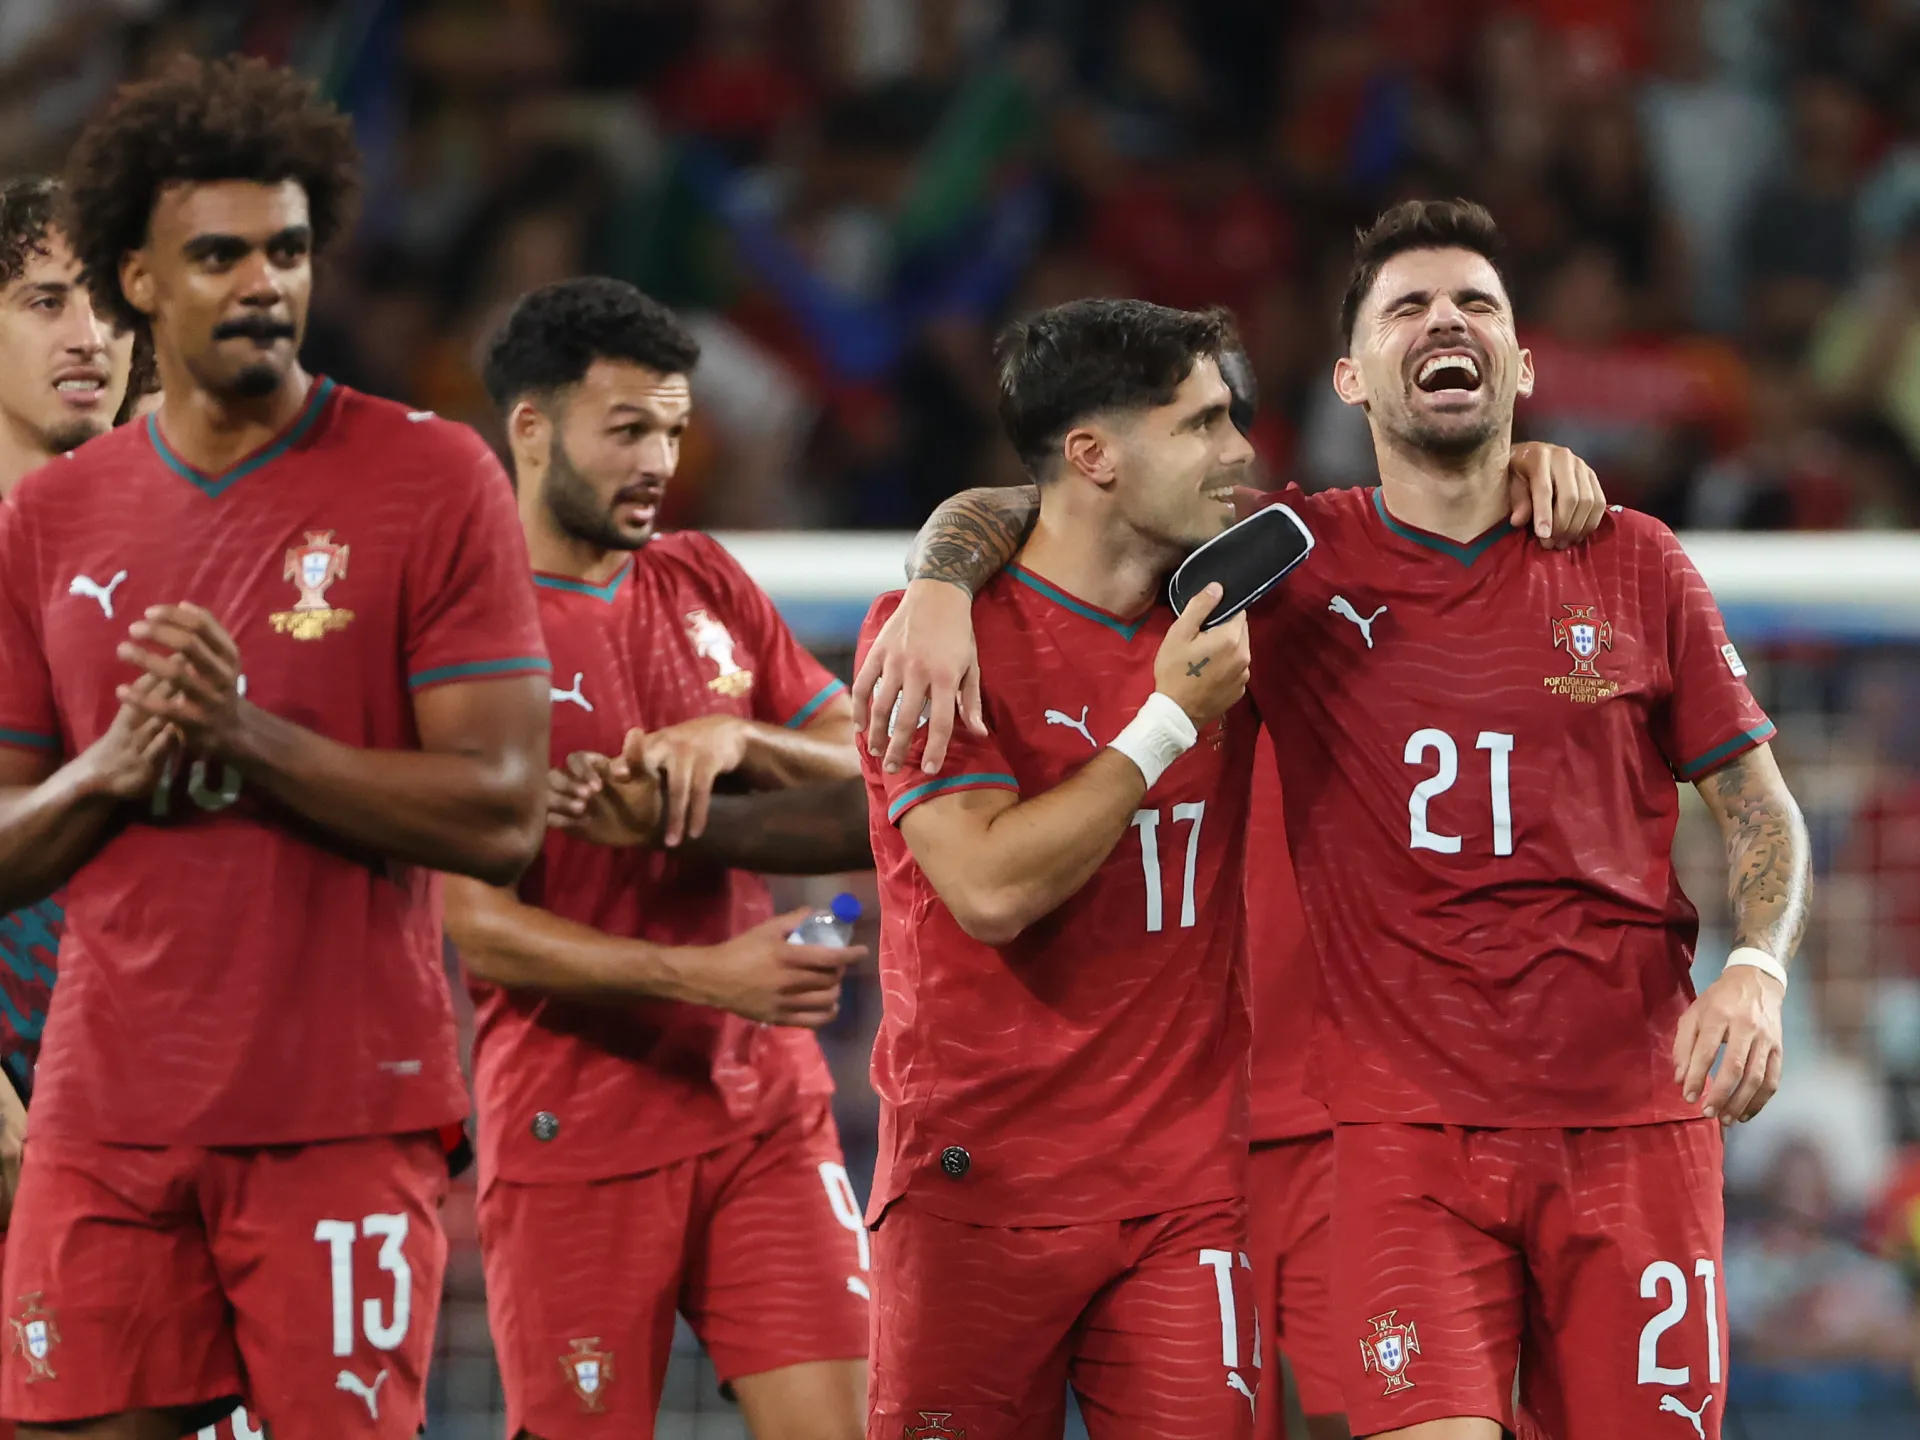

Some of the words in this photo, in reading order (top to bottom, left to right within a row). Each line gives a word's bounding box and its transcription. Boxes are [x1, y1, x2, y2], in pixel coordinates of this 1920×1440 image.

[1551, 686, 1557, 694] 4
[1559, 685, 1596, 695] OUTUBRO
[1570, 694, 1597, 704] PORTO
[1404, 728, 1513, 856] 21
[1131, 800, 1205, 931] 17
[818, 1161, 870, 1271] 9
[314, 1212, 411, 1357] 13
[1637, 1259, 1720, 1385] 21
